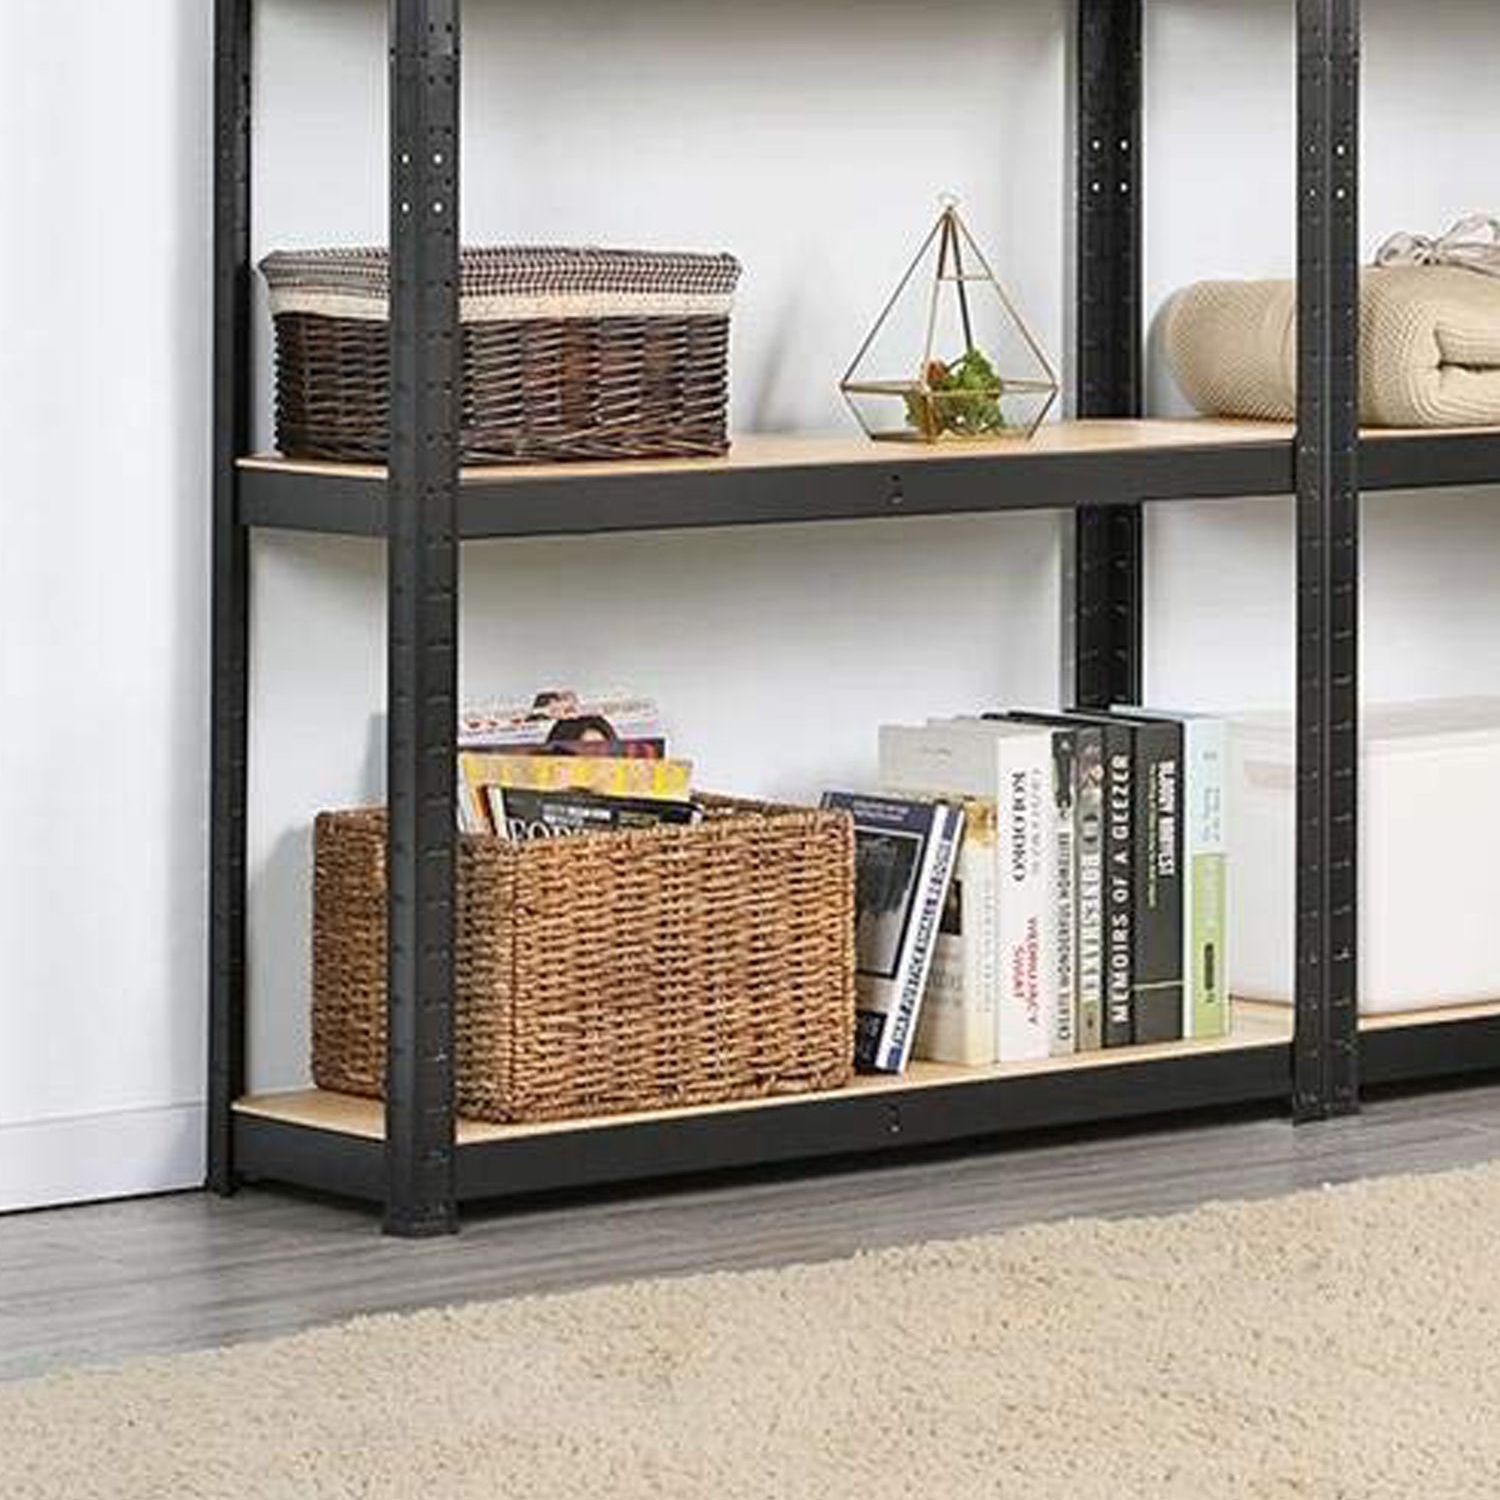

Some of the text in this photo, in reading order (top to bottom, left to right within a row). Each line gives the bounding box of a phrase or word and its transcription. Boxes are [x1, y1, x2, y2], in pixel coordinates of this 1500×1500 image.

[1111, 754, 1131, 1023] MEMOIRS OF A GEEZER
